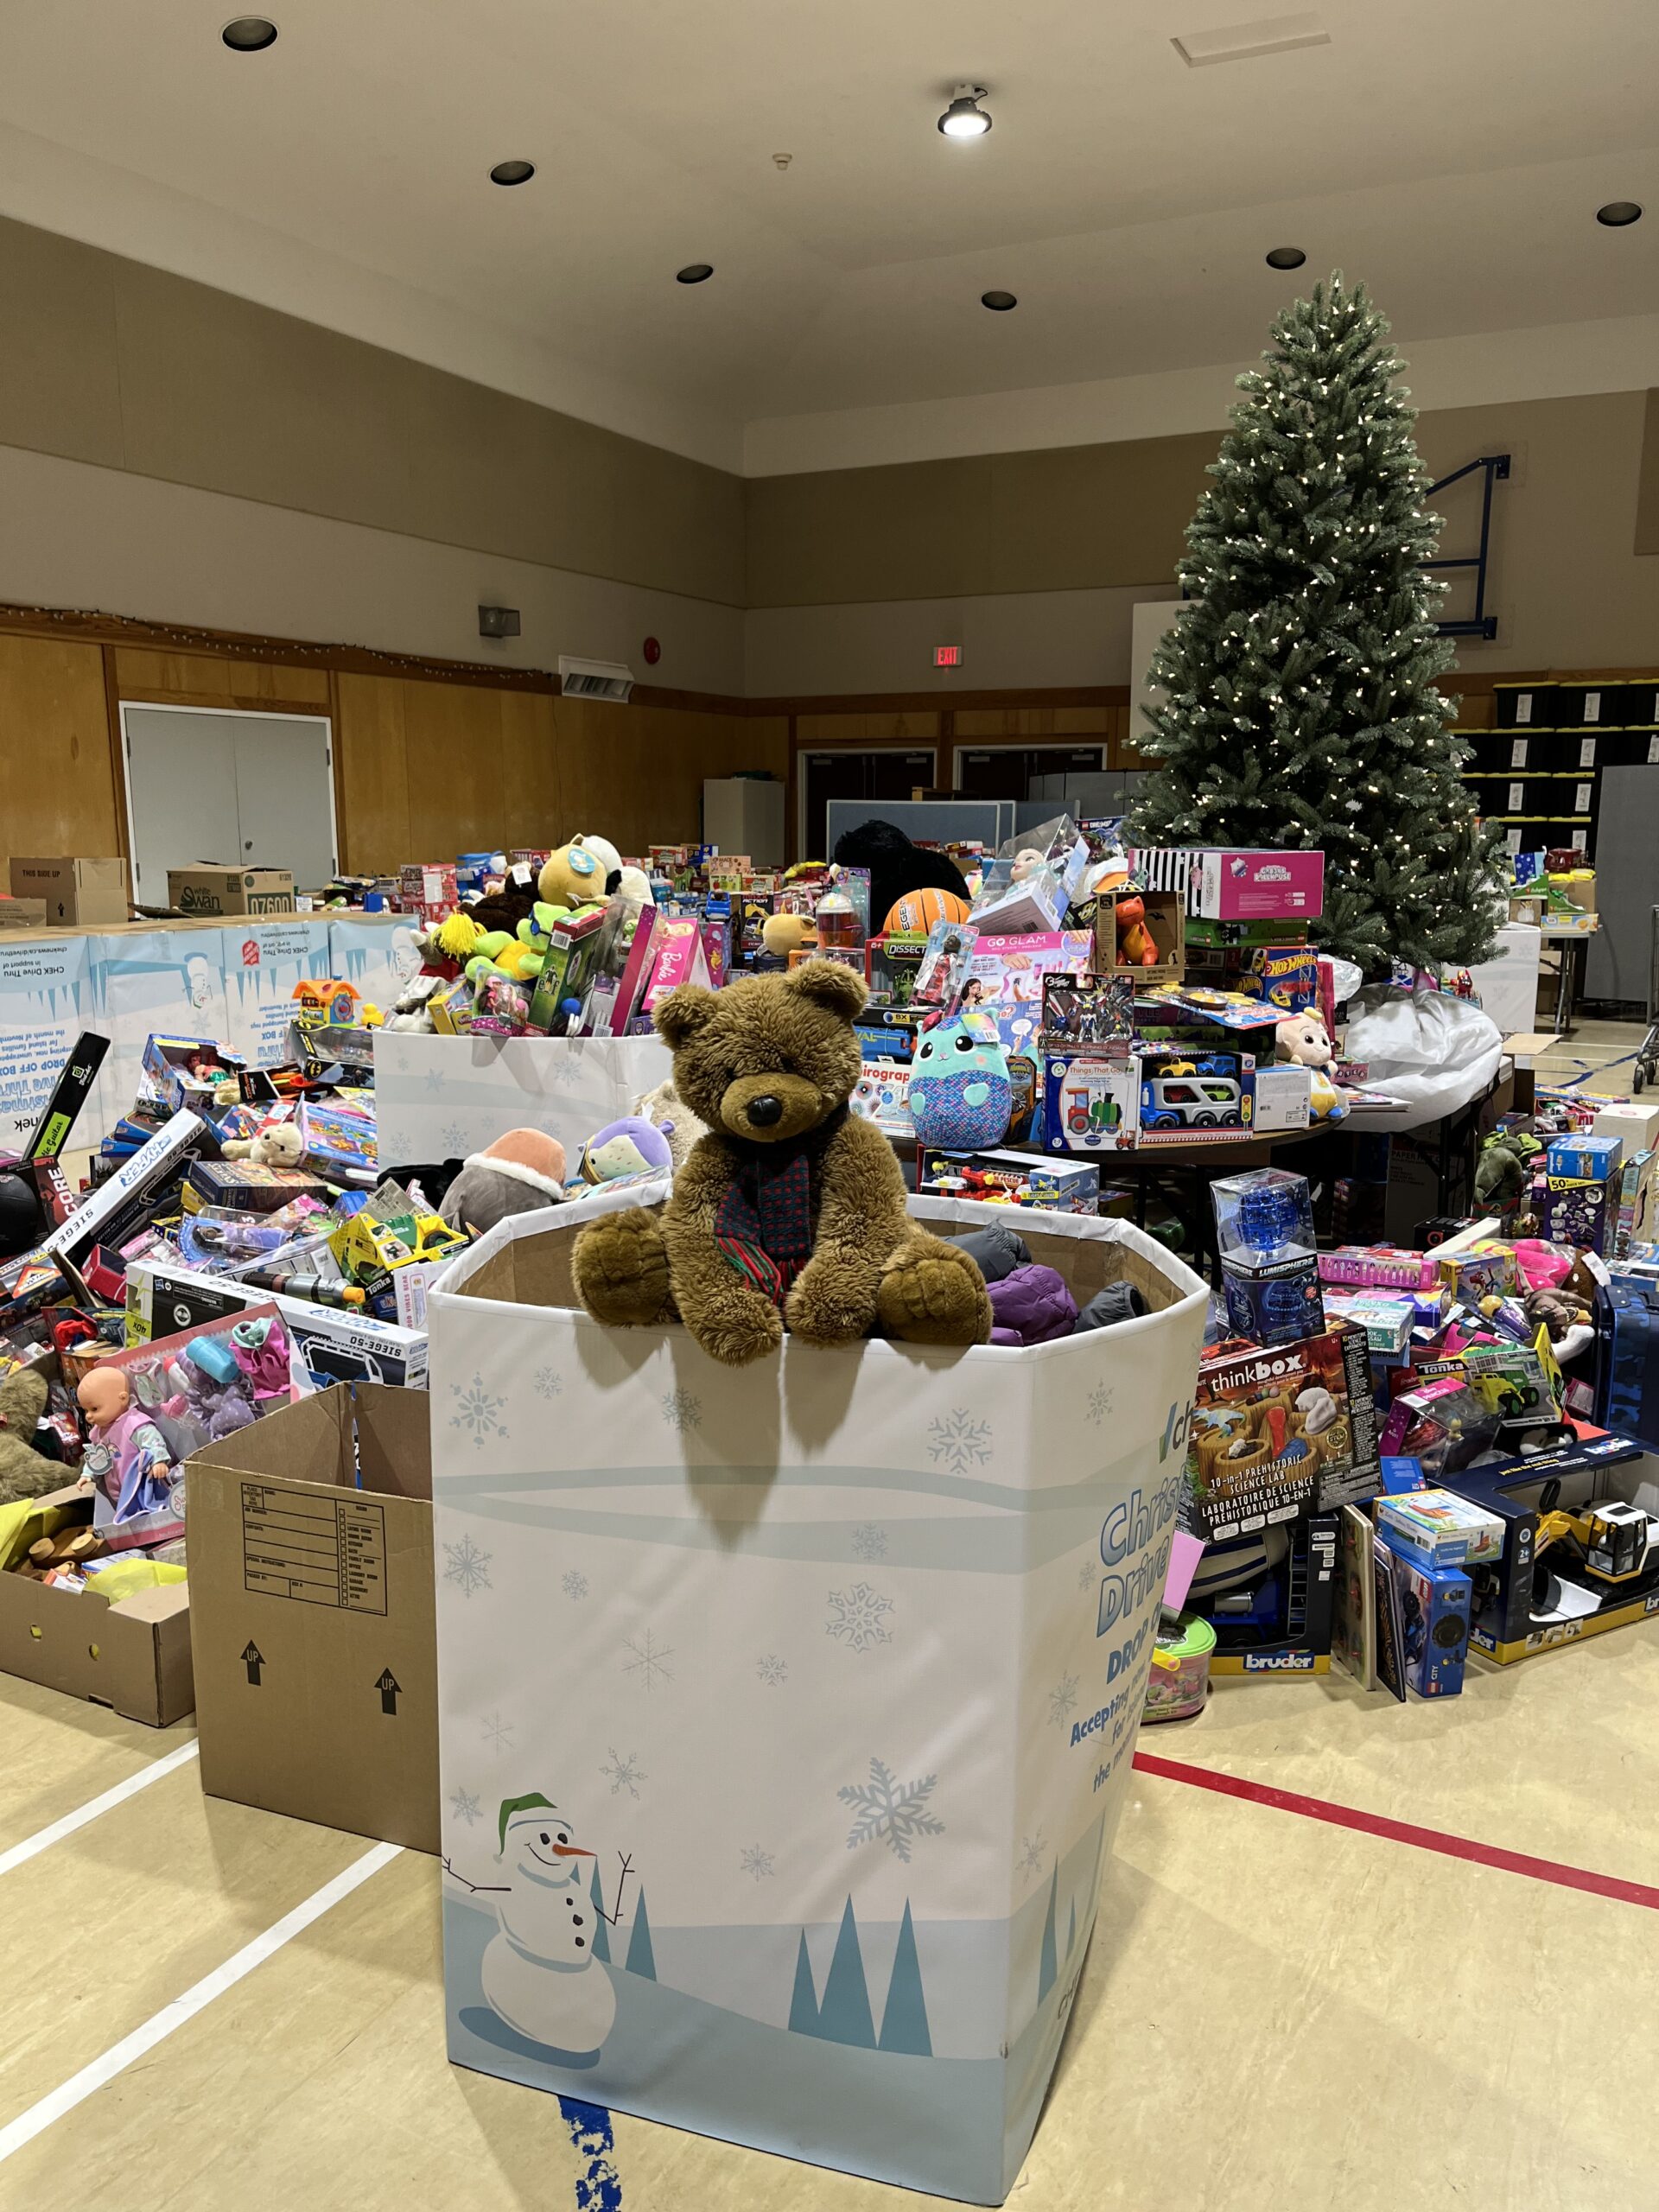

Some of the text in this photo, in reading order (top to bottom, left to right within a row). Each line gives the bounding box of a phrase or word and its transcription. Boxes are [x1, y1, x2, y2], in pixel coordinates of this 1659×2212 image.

[938, 646, 957, 664] EXIT
[180, 887, 220, 909] Swan
[194, 887, 211, 895] white
[987, 935, 1046, 947] GO GLAM
[292, 946, 308, 955] CHEK
[43, 966, 65, 975] CHEK
[658, 952, 682, 981] Barbie
[262, 1031, 276, 1040] BOX
[2, 1043, 27, 1052] families
[19, 1063, 37, 1073] OFF
[41, 1058, 65, 1069] DROP
[48, 1166, 79, 1217] CORE
[48, 1209, 94, 1254] SIEGE-5
[1259, 1256, 1315, 1278] LUMISPHERE
[365, 1278, 391, 1296] Tonka
[350, 1336, 402, 1357] SIEGE-50
[1419, 1362, 1464, 1375] Tonka
[1211, 1455, 1302, 1489] 10-in-1 PREHISTORIC
[1230, 1470, 1286, 1495] SCIENCE LAB
[1202, 1490, 1264, 1517] LABORATOIRE
[1266, 1486, 1277, 1497] DE
[1279, 1476, 1314, 1494] SCIENCE
[1282, 1488, 1311, 1504] 10-EN-1
[1100, 1473, 1180, 1567] Chris
[1096, 1535, 1170, 1638] Drive
[1471, 1629, 1494, 1648] der
[246, 1649, 259, 1662] UP
[1107, 1617, 1149, 1685] DROP
[1246, 1654, 1312, 1669] bruder
[381, 1678, 394, 1691] UP
[1071, 1685, 1129, 1748] Accepting
[1093, 1762, 1110, 1793] the
